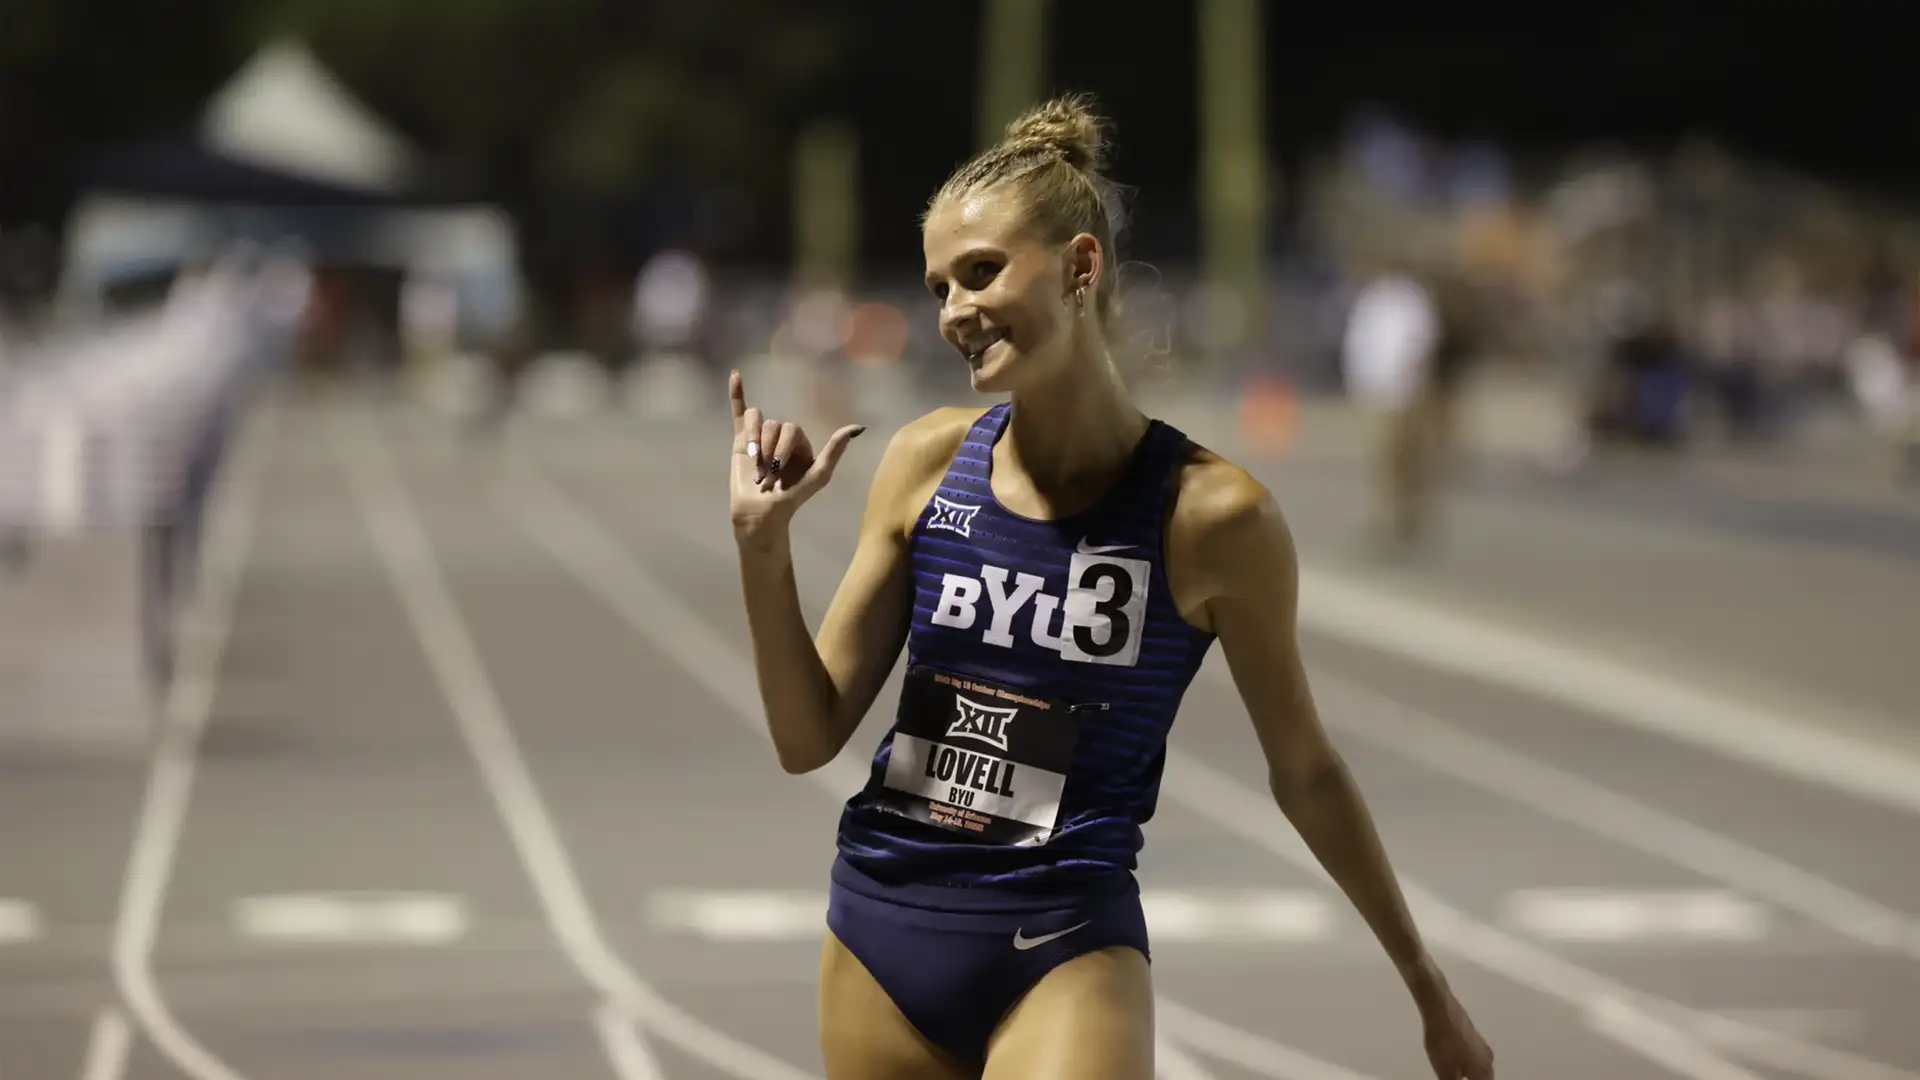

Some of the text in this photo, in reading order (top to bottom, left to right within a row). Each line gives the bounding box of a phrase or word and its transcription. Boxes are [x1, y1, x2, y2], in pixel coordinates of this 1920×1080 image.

[931, 564, 1066, 651] BYU
[1073, 563, 1133, 657] 3
[925, 744, 1016, 798] LOVELL
[949, 786, 975, 807] BYU
